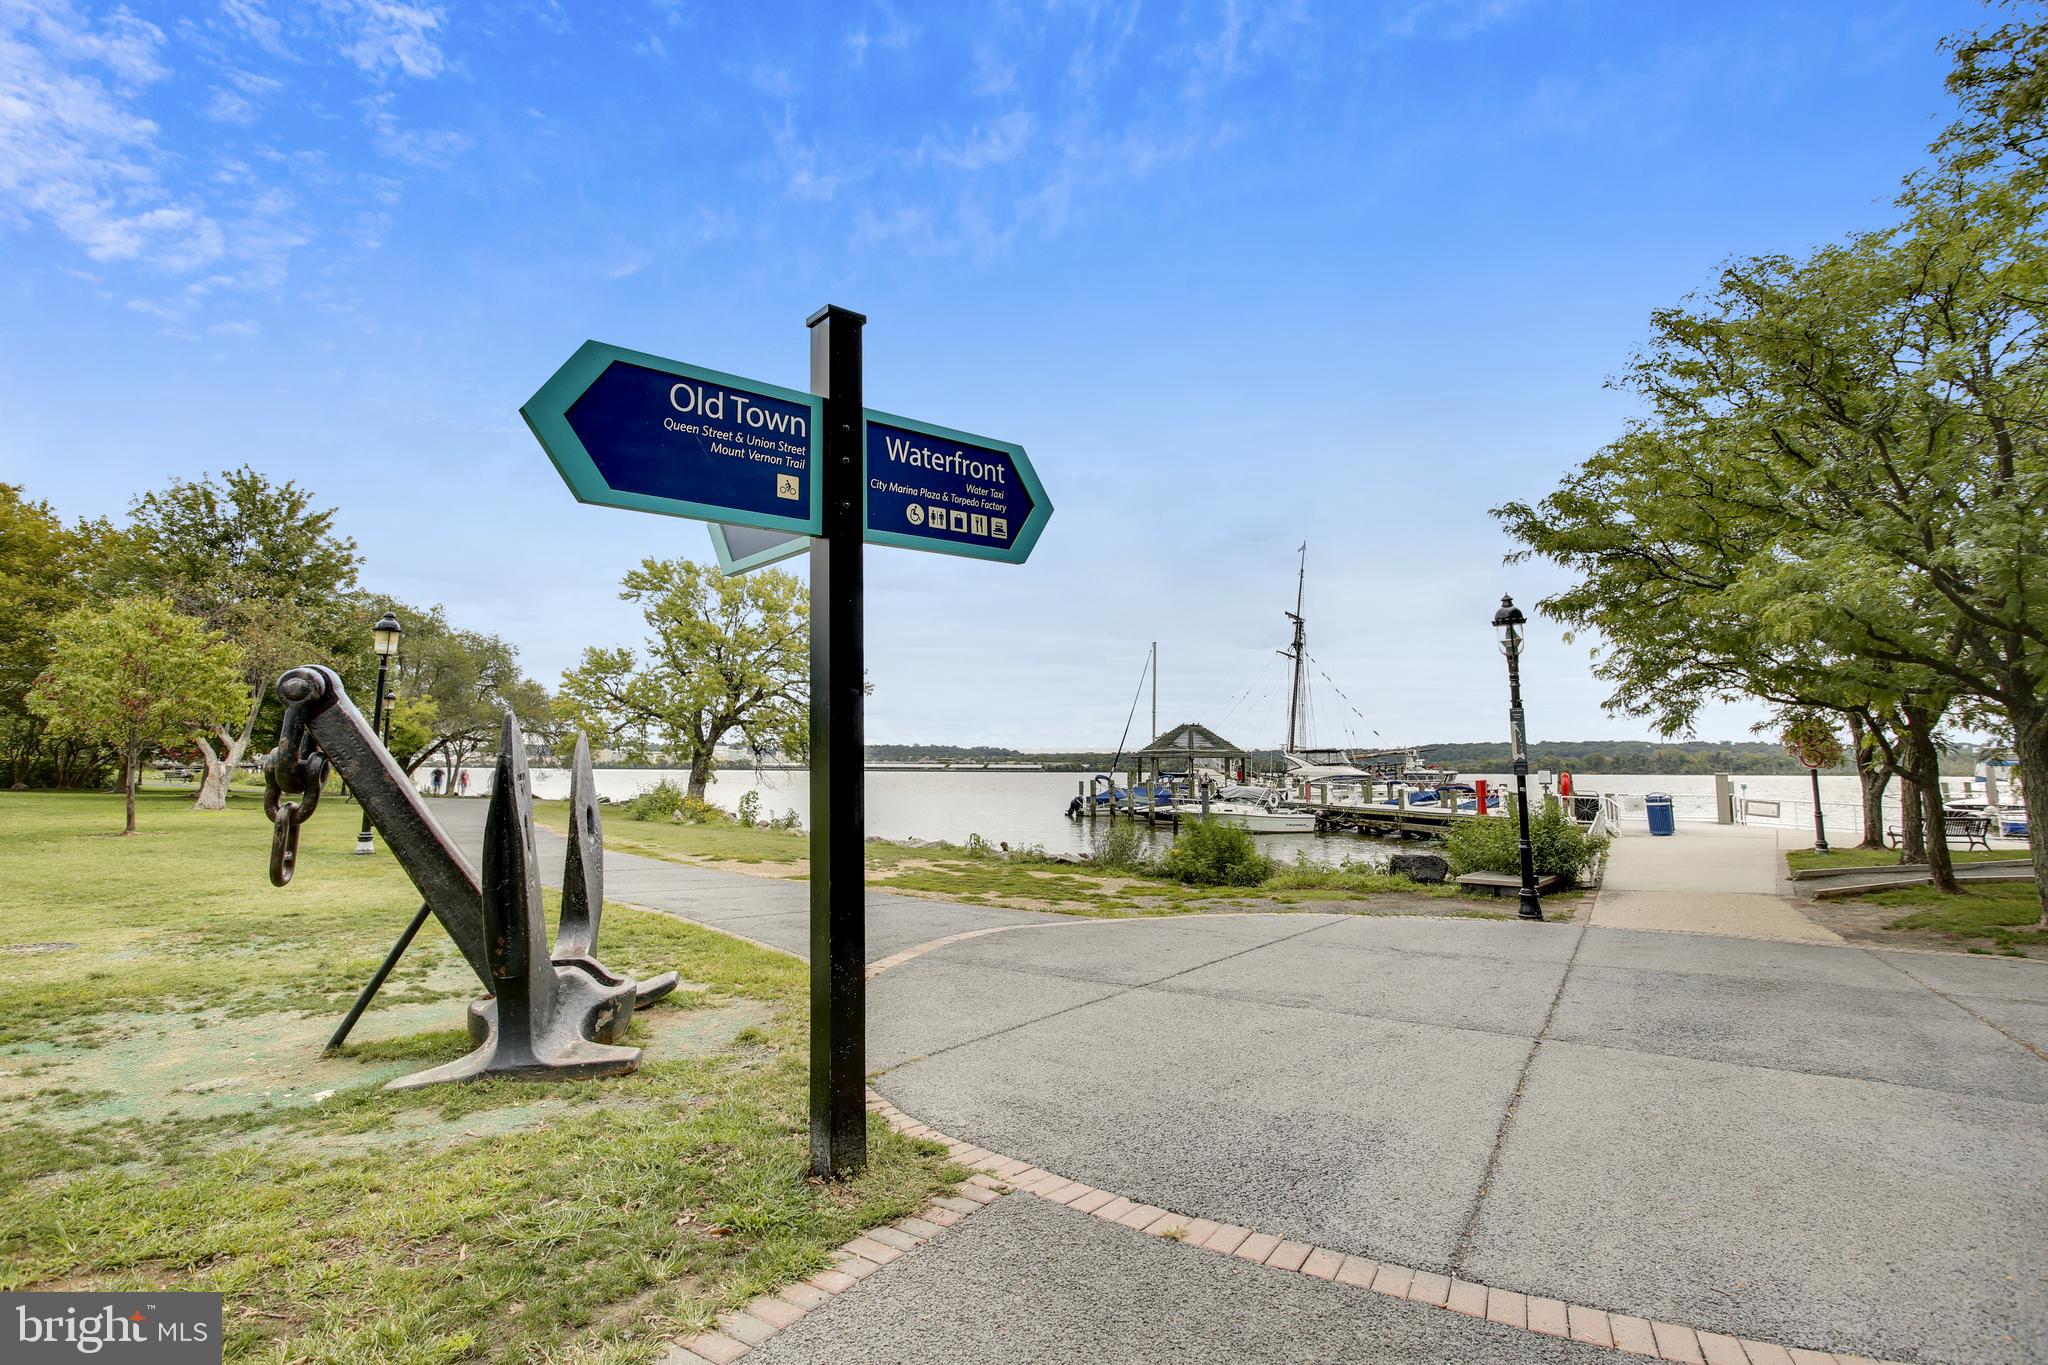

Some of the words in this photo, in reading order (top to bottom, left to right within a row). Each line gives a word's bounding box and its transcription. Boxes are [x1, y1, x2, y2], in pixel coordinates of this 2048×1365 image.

[669, 383, 724, 420] Old
[730, 395, 806, 438] Town
[663, 417, 699, 435] Queen
[702, 425, 733, 442] Street
[735, 432, 744, 444] &
[746, 434, 776, 450] Union
[778, 441, 806, 456] Street
[710, 442, 745, 459] Mount
[748, 449, 782, 465] Vernon
[785, 456, 806, 470] Trail
[885, 436, 1005, 484] Waterfront
[870, 478, 887, 492] City
[889, 482, 918, 496] Marina
[920, 487, 941, 501] Plaza
[942, 492, 949, 502] &
[950, 493, 980, 508] Torpedo
[980, 500, 1007, 514] Factory
[966, 483, 989, 497] Water
[990, 489, 1005, 500] Taxi
